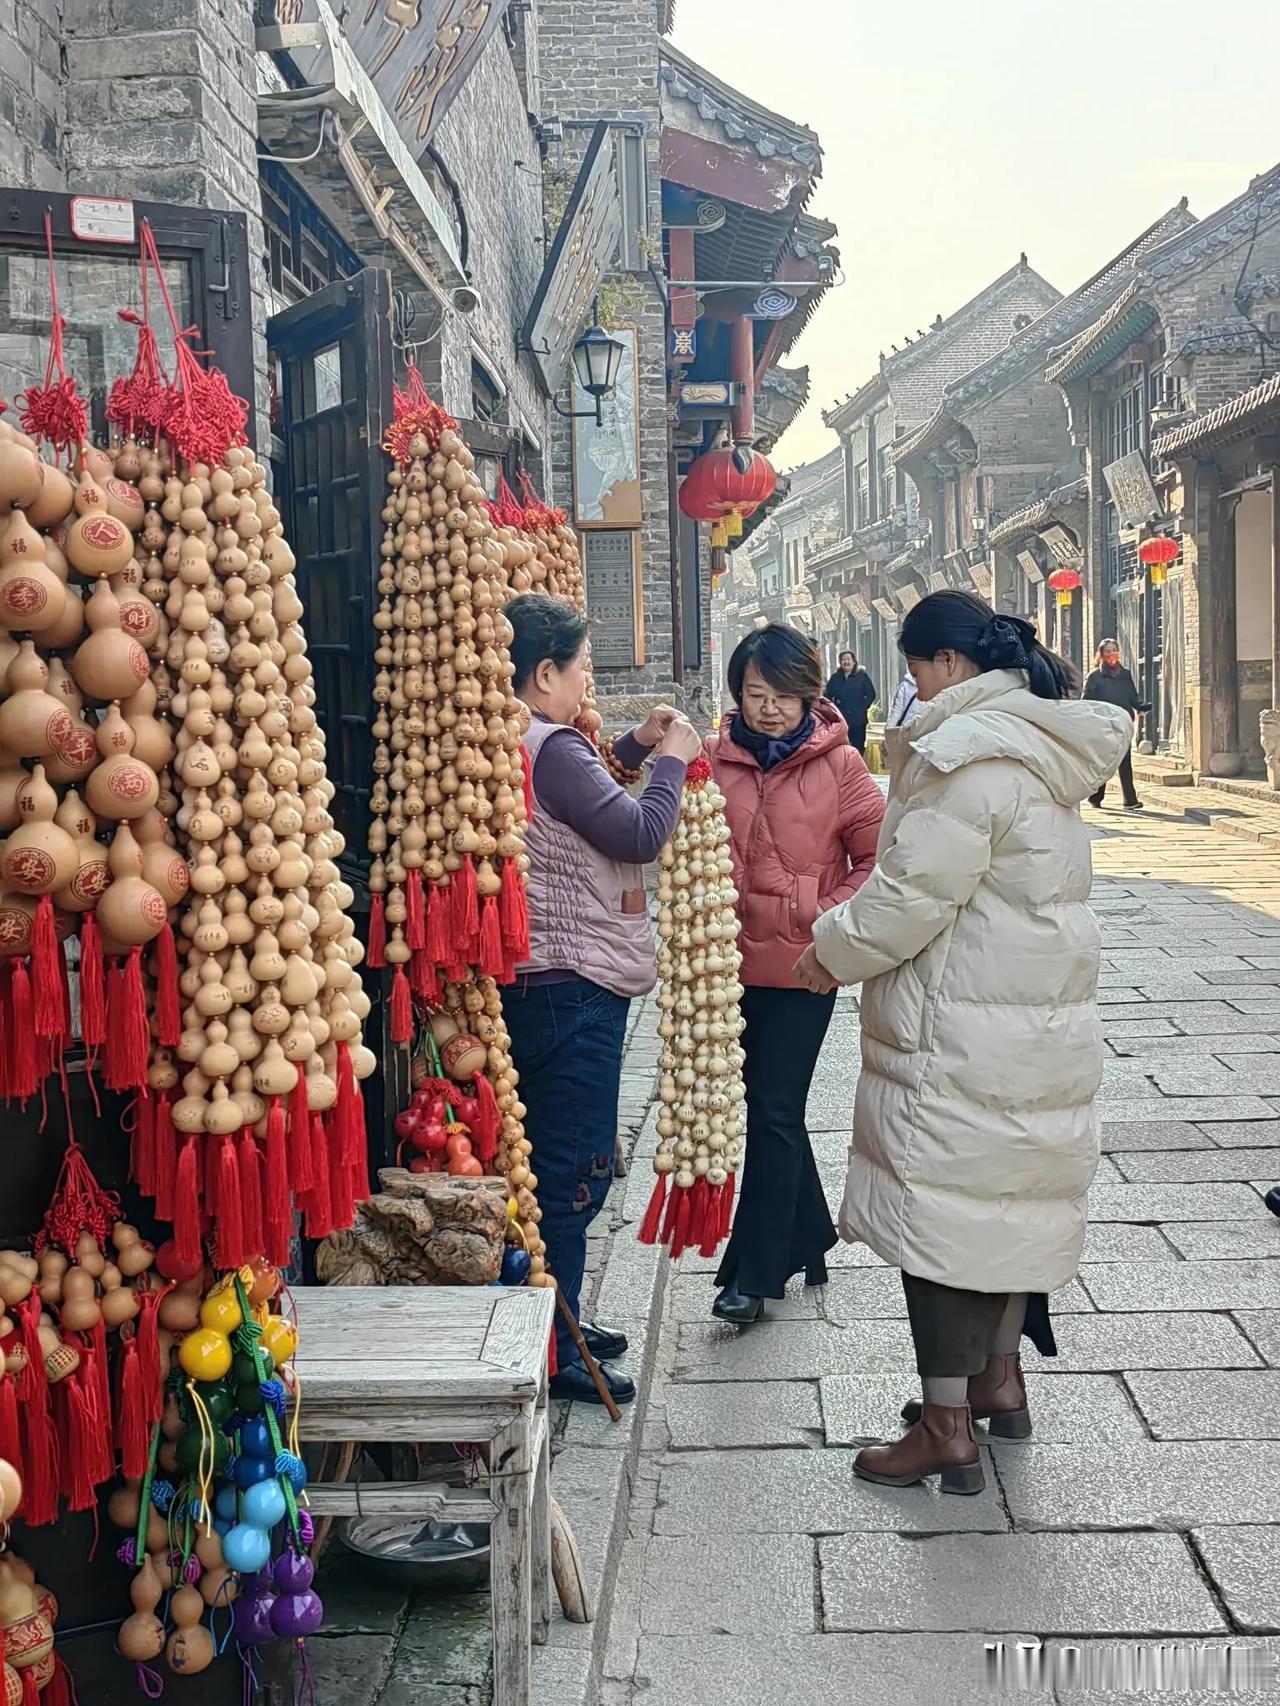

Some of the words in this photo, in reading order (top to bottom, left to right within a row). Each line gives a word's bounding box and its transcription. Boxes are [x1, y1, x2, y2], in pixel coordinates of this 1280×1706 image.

[82, 489, 99, 505] 福
[94, 522, 117, 539] 人
[11, 538, 28, 554] 福
[122, 568, 138, 585] 福
[128, 609, 150, 629] 财
[61, 680, 75, 695] 福
[111, 731, 128, 748] 福
[66, 737, 92, 761] 平
[21, 796, 36, 813] 福
[76, 818, 91, 835] 福
[11, 858, 45, 882] 安
[81, 871, 110, 893] 安
